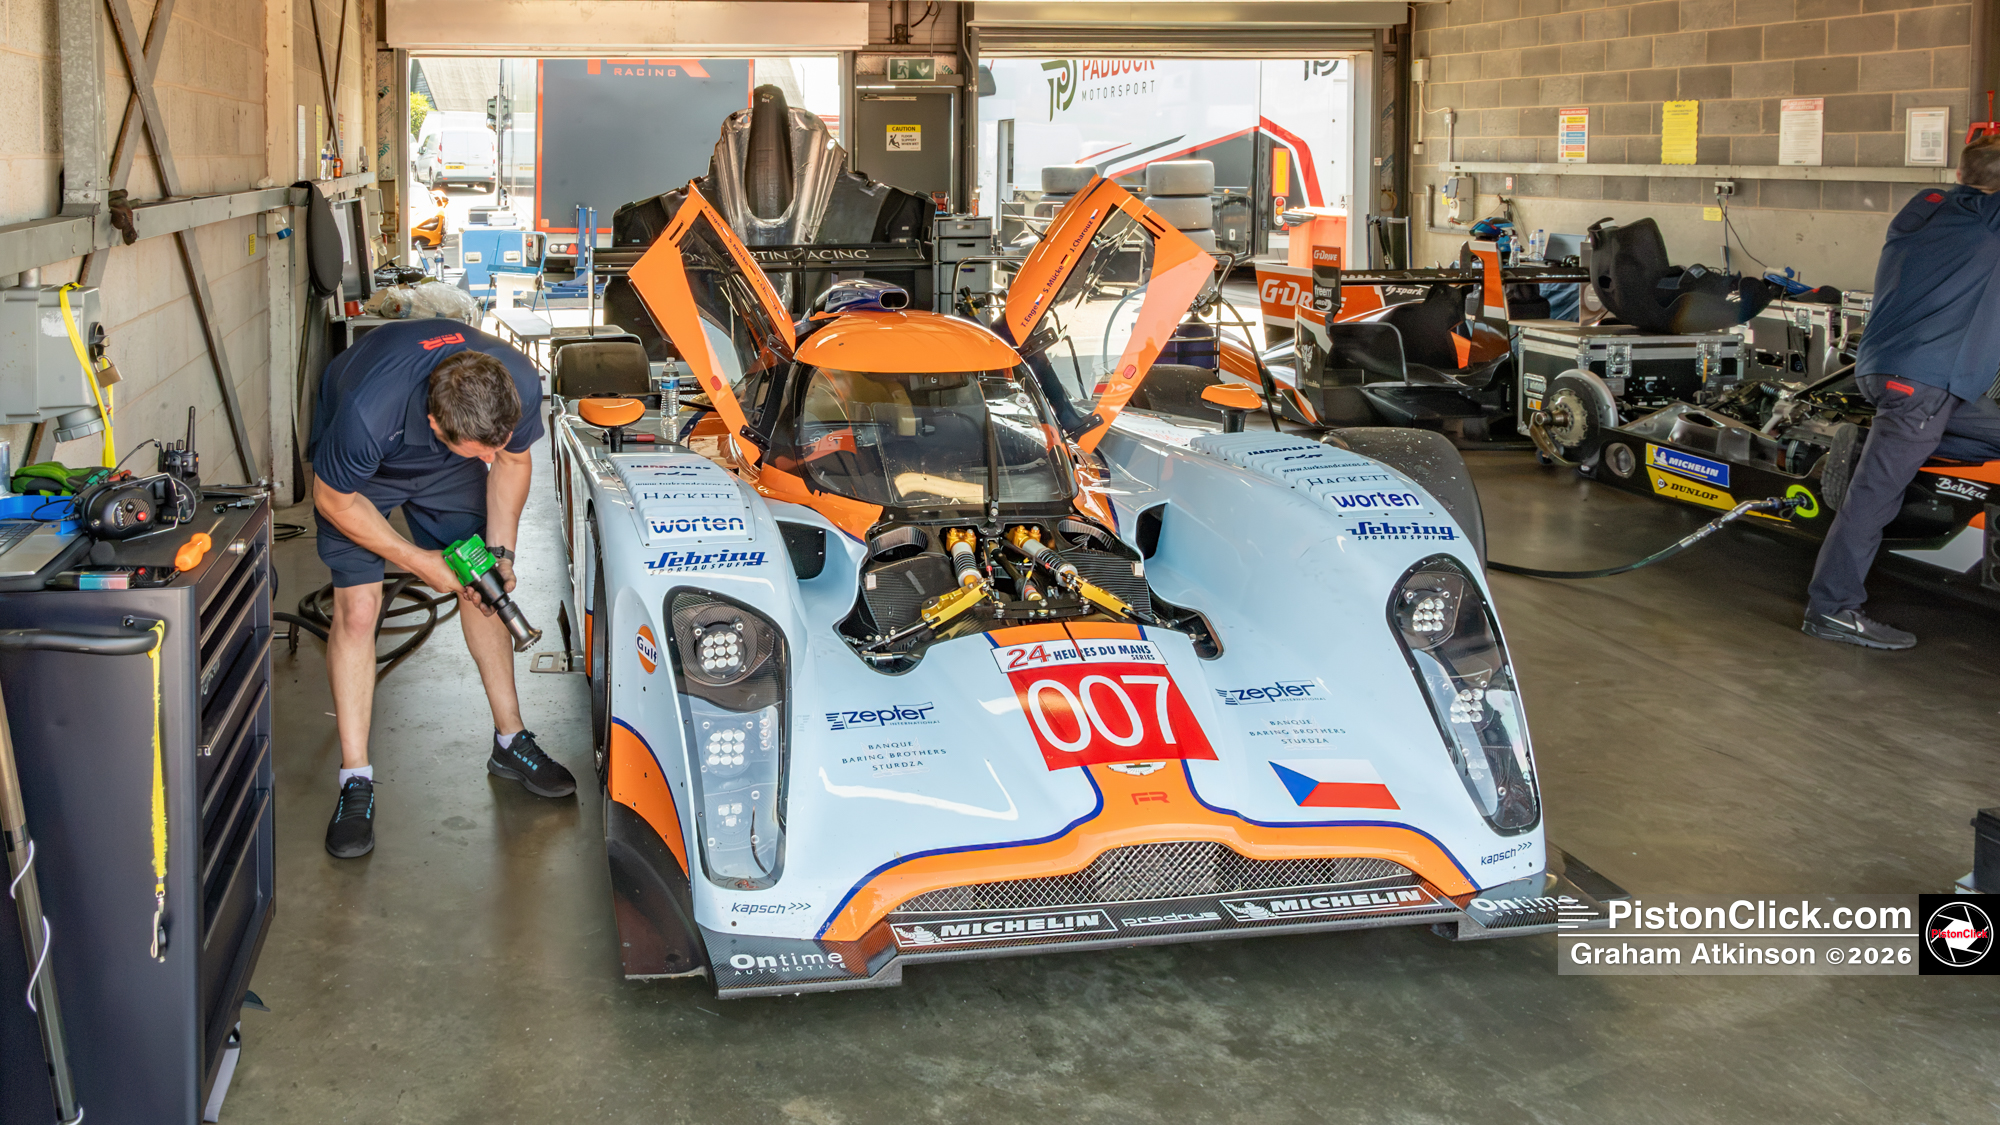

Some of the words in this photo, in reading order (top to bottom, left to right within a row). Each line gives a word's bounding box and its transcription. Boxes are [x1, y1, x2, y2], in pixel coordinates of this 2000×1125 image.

[614, 67, 677, 77] RACING
[1082, 80, 1155, 102] MOTORSPORT
[750, 251, 788, 261] RTIN
[807, 249, 869, 260] ACING
[1394, 286, 1424, 296] spark
[1020, 305, 1039, 328] T.Enge
[1668, 457, 1719, 477] MICHELIN
[1306, 474, 1389, 486] HACKETT
[644, 492, 734, 500] HACKETT
[1331, 491, 1420, 508] worten
[1670, 483, 1719, 501] DUNLOP
[650, 516, 744, 534] worten
[1345, 521, 1460, 541] Sebring
[643, 549, 769, 570] Sebring
[636, 636, 657, 663] Gulf
[1007, 644, 1051, 670] 24
[1098, 645, 1116, 656] DU
[1117, 644, 1151, 655] MANS
[1230, 681, 1315, 703] zepter
[841, 704, 934, 727] zepter
[1027, 674, 1177, 753] 007
[1249, 728, 1290, 737] BARING
[868, 741, 914, 750] BANQUE
[841, 754, 884, 764] BARING
[889, 749, 947, 759] BROTHERS
[872, 760, 924, 771] STURDZA
[1480, 848, 1517, 866] kapsch
[731, 902, 786, 915] kapsch
[1270, 889, 1422, 913] MICHELIN
[940, 914, 1100, 937] MICHELIN
[729, 952, 843, 970] Ontime
[734, 962, 847, 976] AUTOMOTIVE
